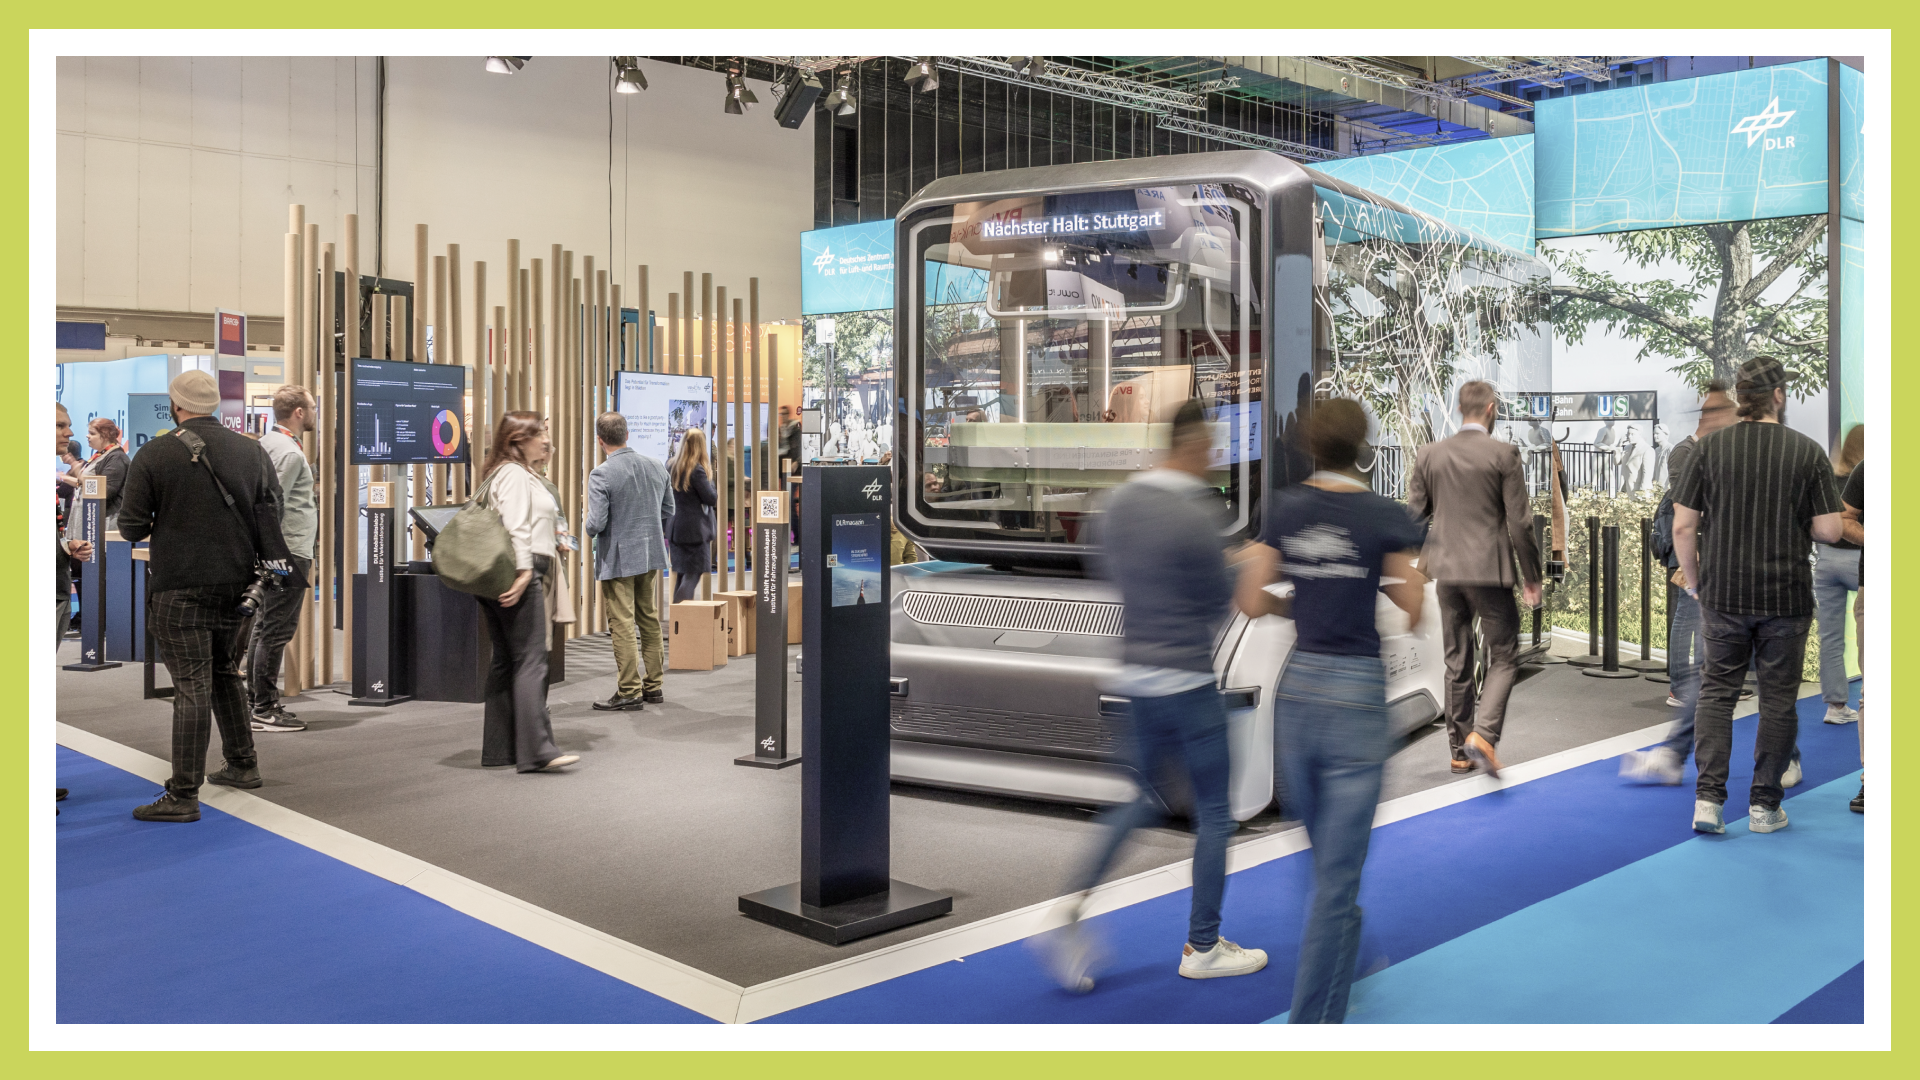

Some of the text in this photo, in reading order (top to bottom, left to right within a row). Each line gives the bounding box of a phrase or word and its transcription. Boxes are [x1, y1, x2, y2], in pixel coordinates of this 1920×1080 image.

[1765, 136, 1796, 151] DLR
[983, 219, 1050, 237] Nächster
[1052, 216, 1090, 233] Halt:
[1093, 211, 1162, 231] Stuttgart
[839, 253, 890, 265] Deutsches Zentrum
[824, 268, 836, 276] DLR
[839, 266, 848, 275] für
[848, 265, 861, 274] Luft-
[861, 264, 873, 273] und
